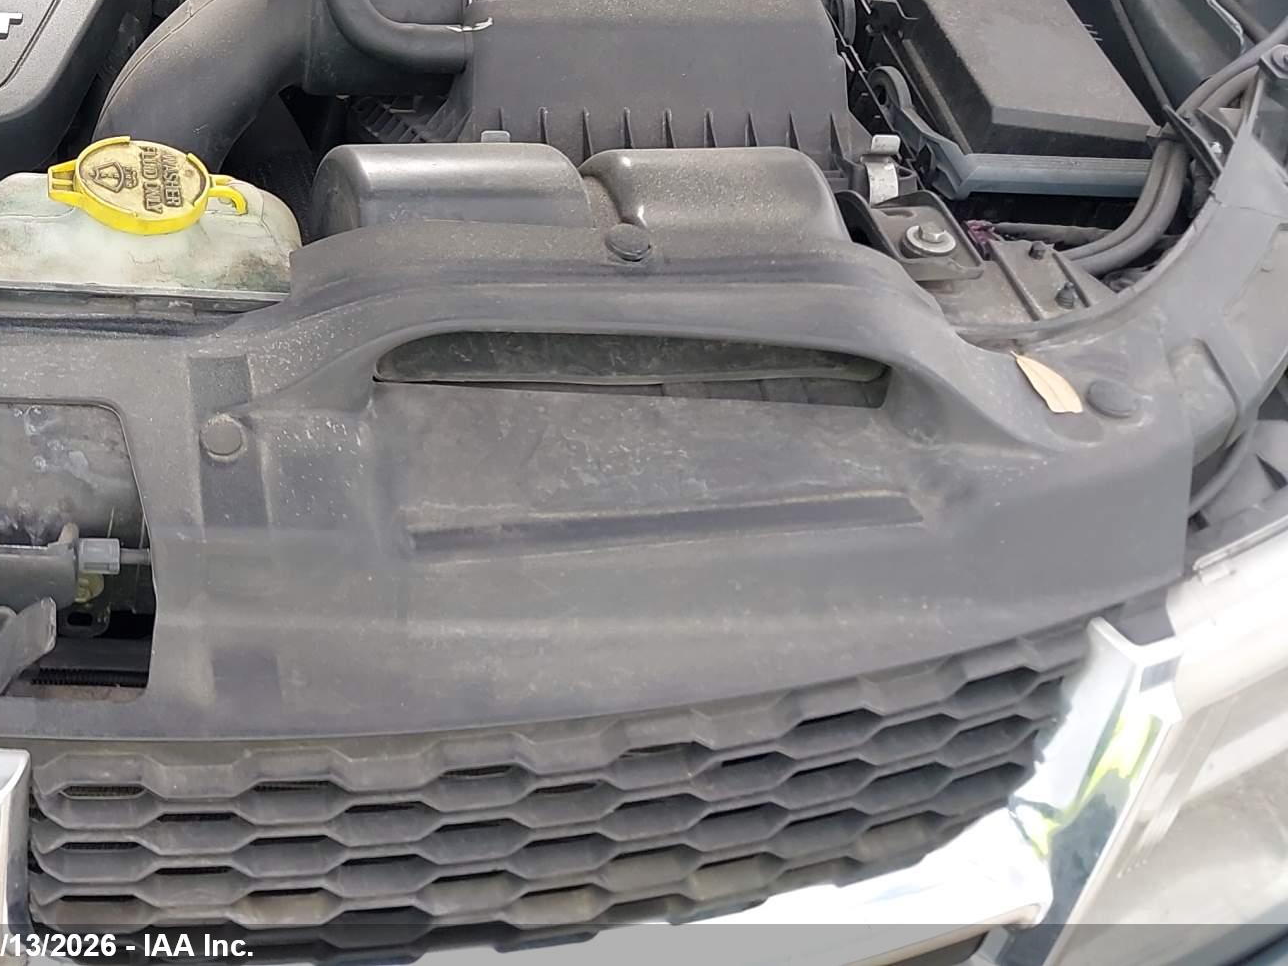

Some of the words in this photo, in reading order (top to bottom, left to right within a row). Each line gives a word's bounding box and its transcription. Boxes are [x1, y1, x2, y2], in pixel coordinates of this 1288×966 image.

[138, 145, 159, 180] FLUID
[160, 151, 183, 208] WASHER
[142, 181, 164, 214] ONLY
